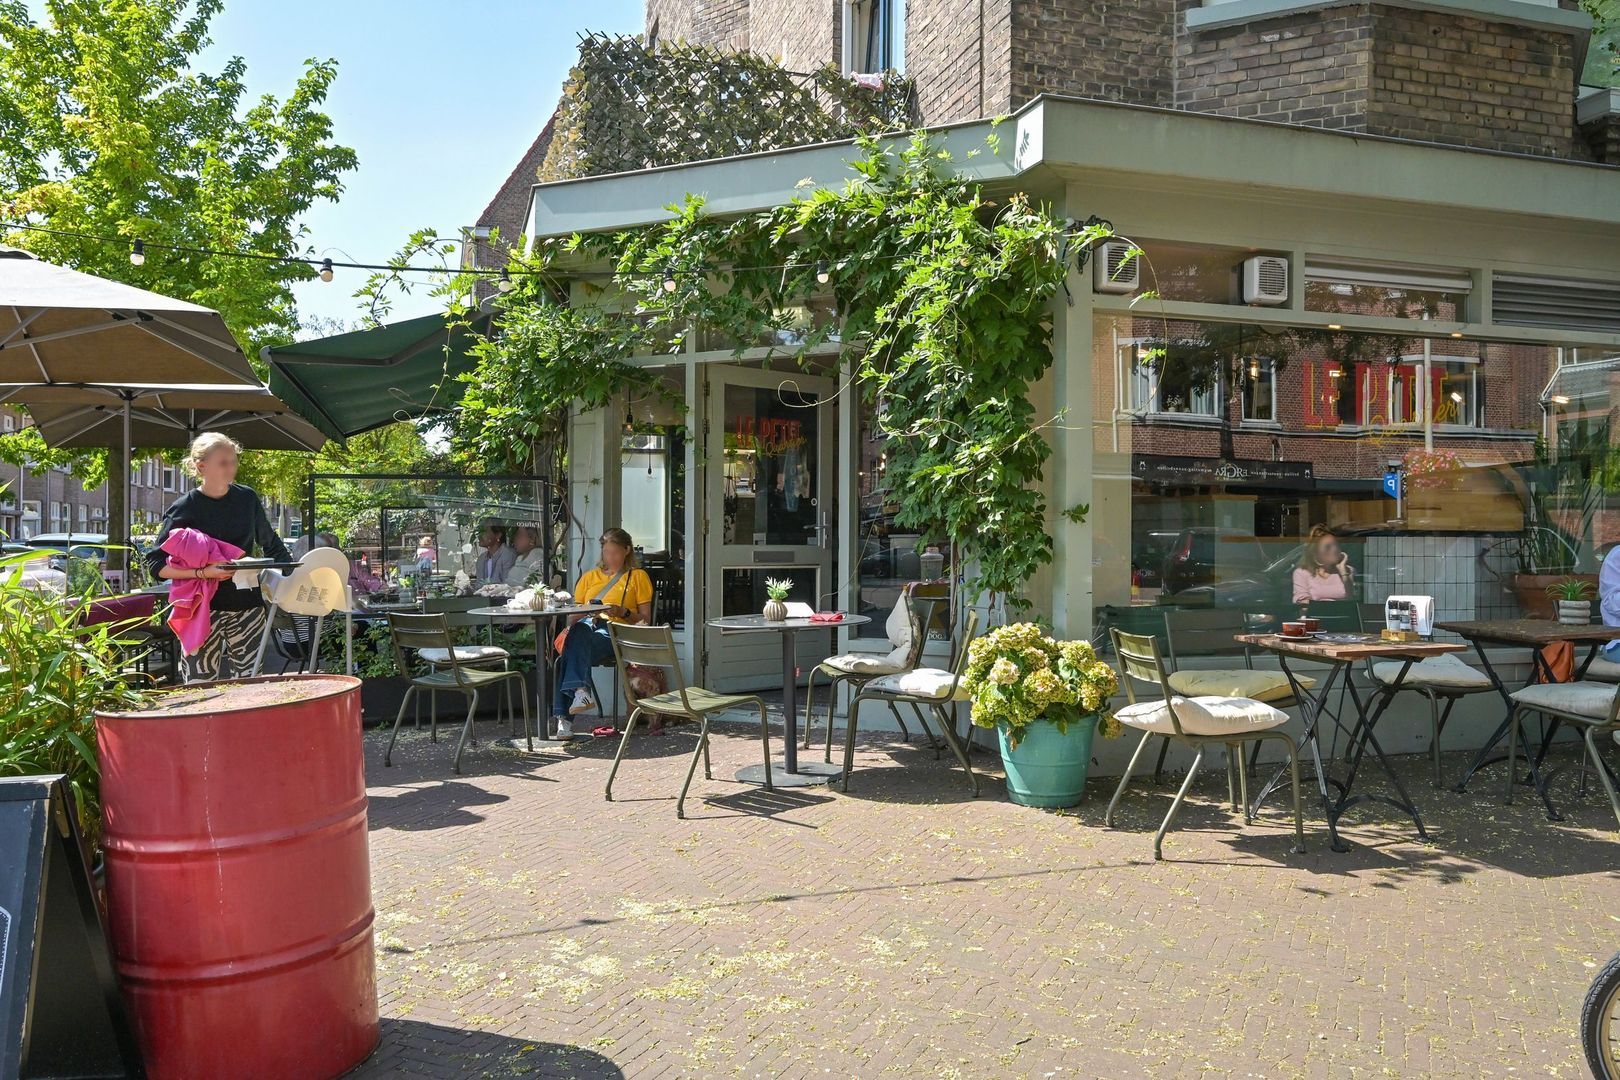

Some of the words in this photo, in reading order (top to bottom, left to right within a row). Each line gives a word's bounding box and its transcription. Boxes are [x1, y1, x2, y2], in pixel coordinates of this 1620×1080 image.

[1302, 360, 1344, 428] LE
[1355, 361, 1449, 427] PETIT
[735, 415, 755, 448] LE
